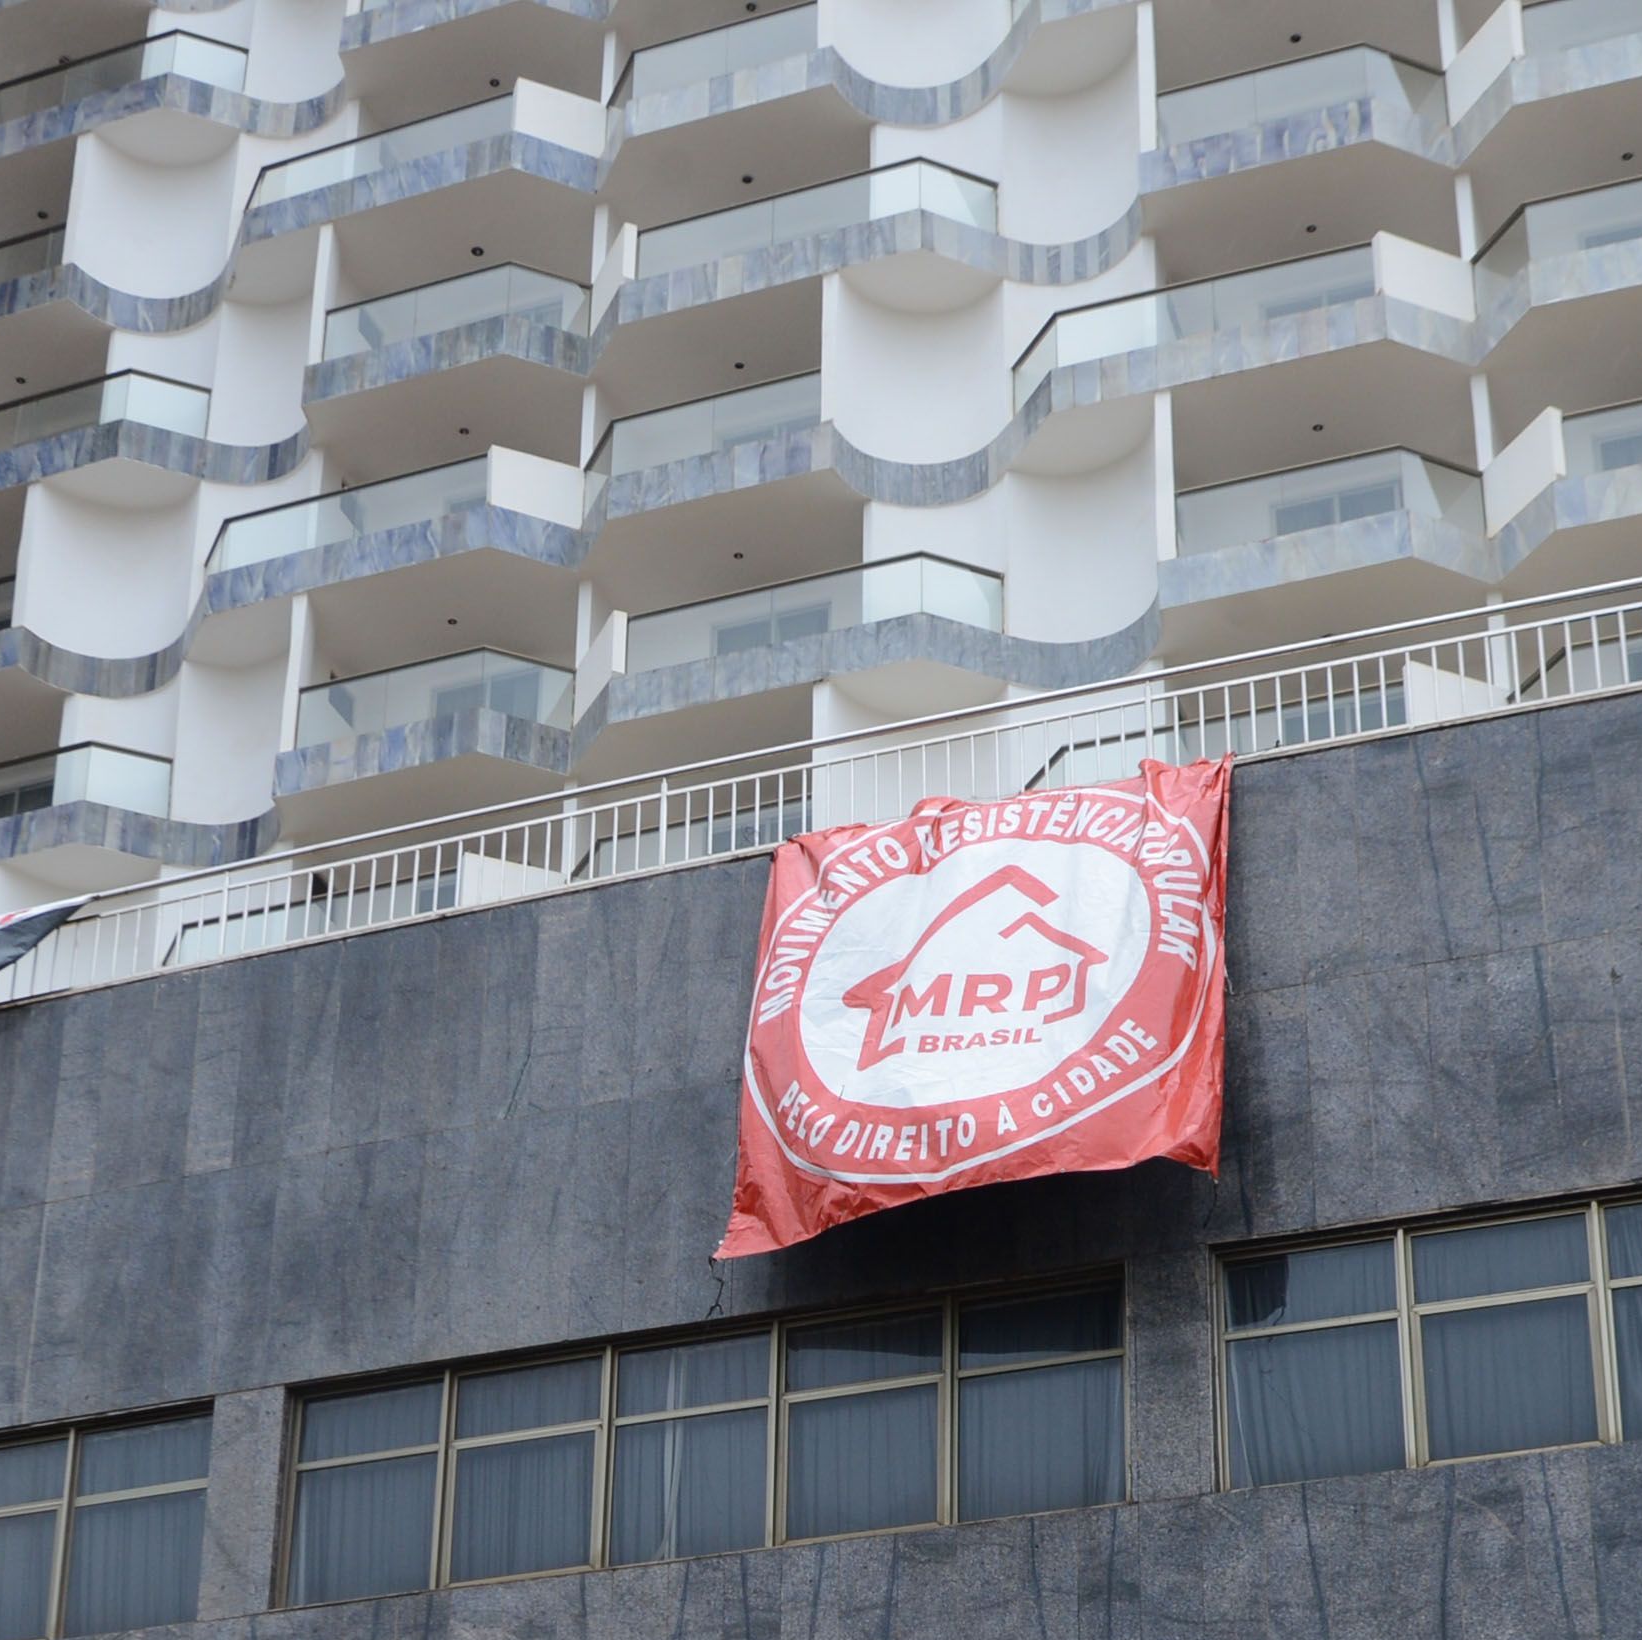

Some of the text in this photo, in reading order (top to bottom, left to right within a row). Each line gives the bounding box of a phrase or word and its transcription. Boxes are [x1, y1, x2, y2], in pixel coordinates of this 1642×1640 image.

[758, 794, 1202, 1025] MOVIMENTO RESISTÊNCIA POPULAR
[891, 963, 1071, 1028] MRP
[918, 1028, 1042, 1053] BRASIL
[777, 1018, 1158, 1161] PELO DIREITO À CIDADE
